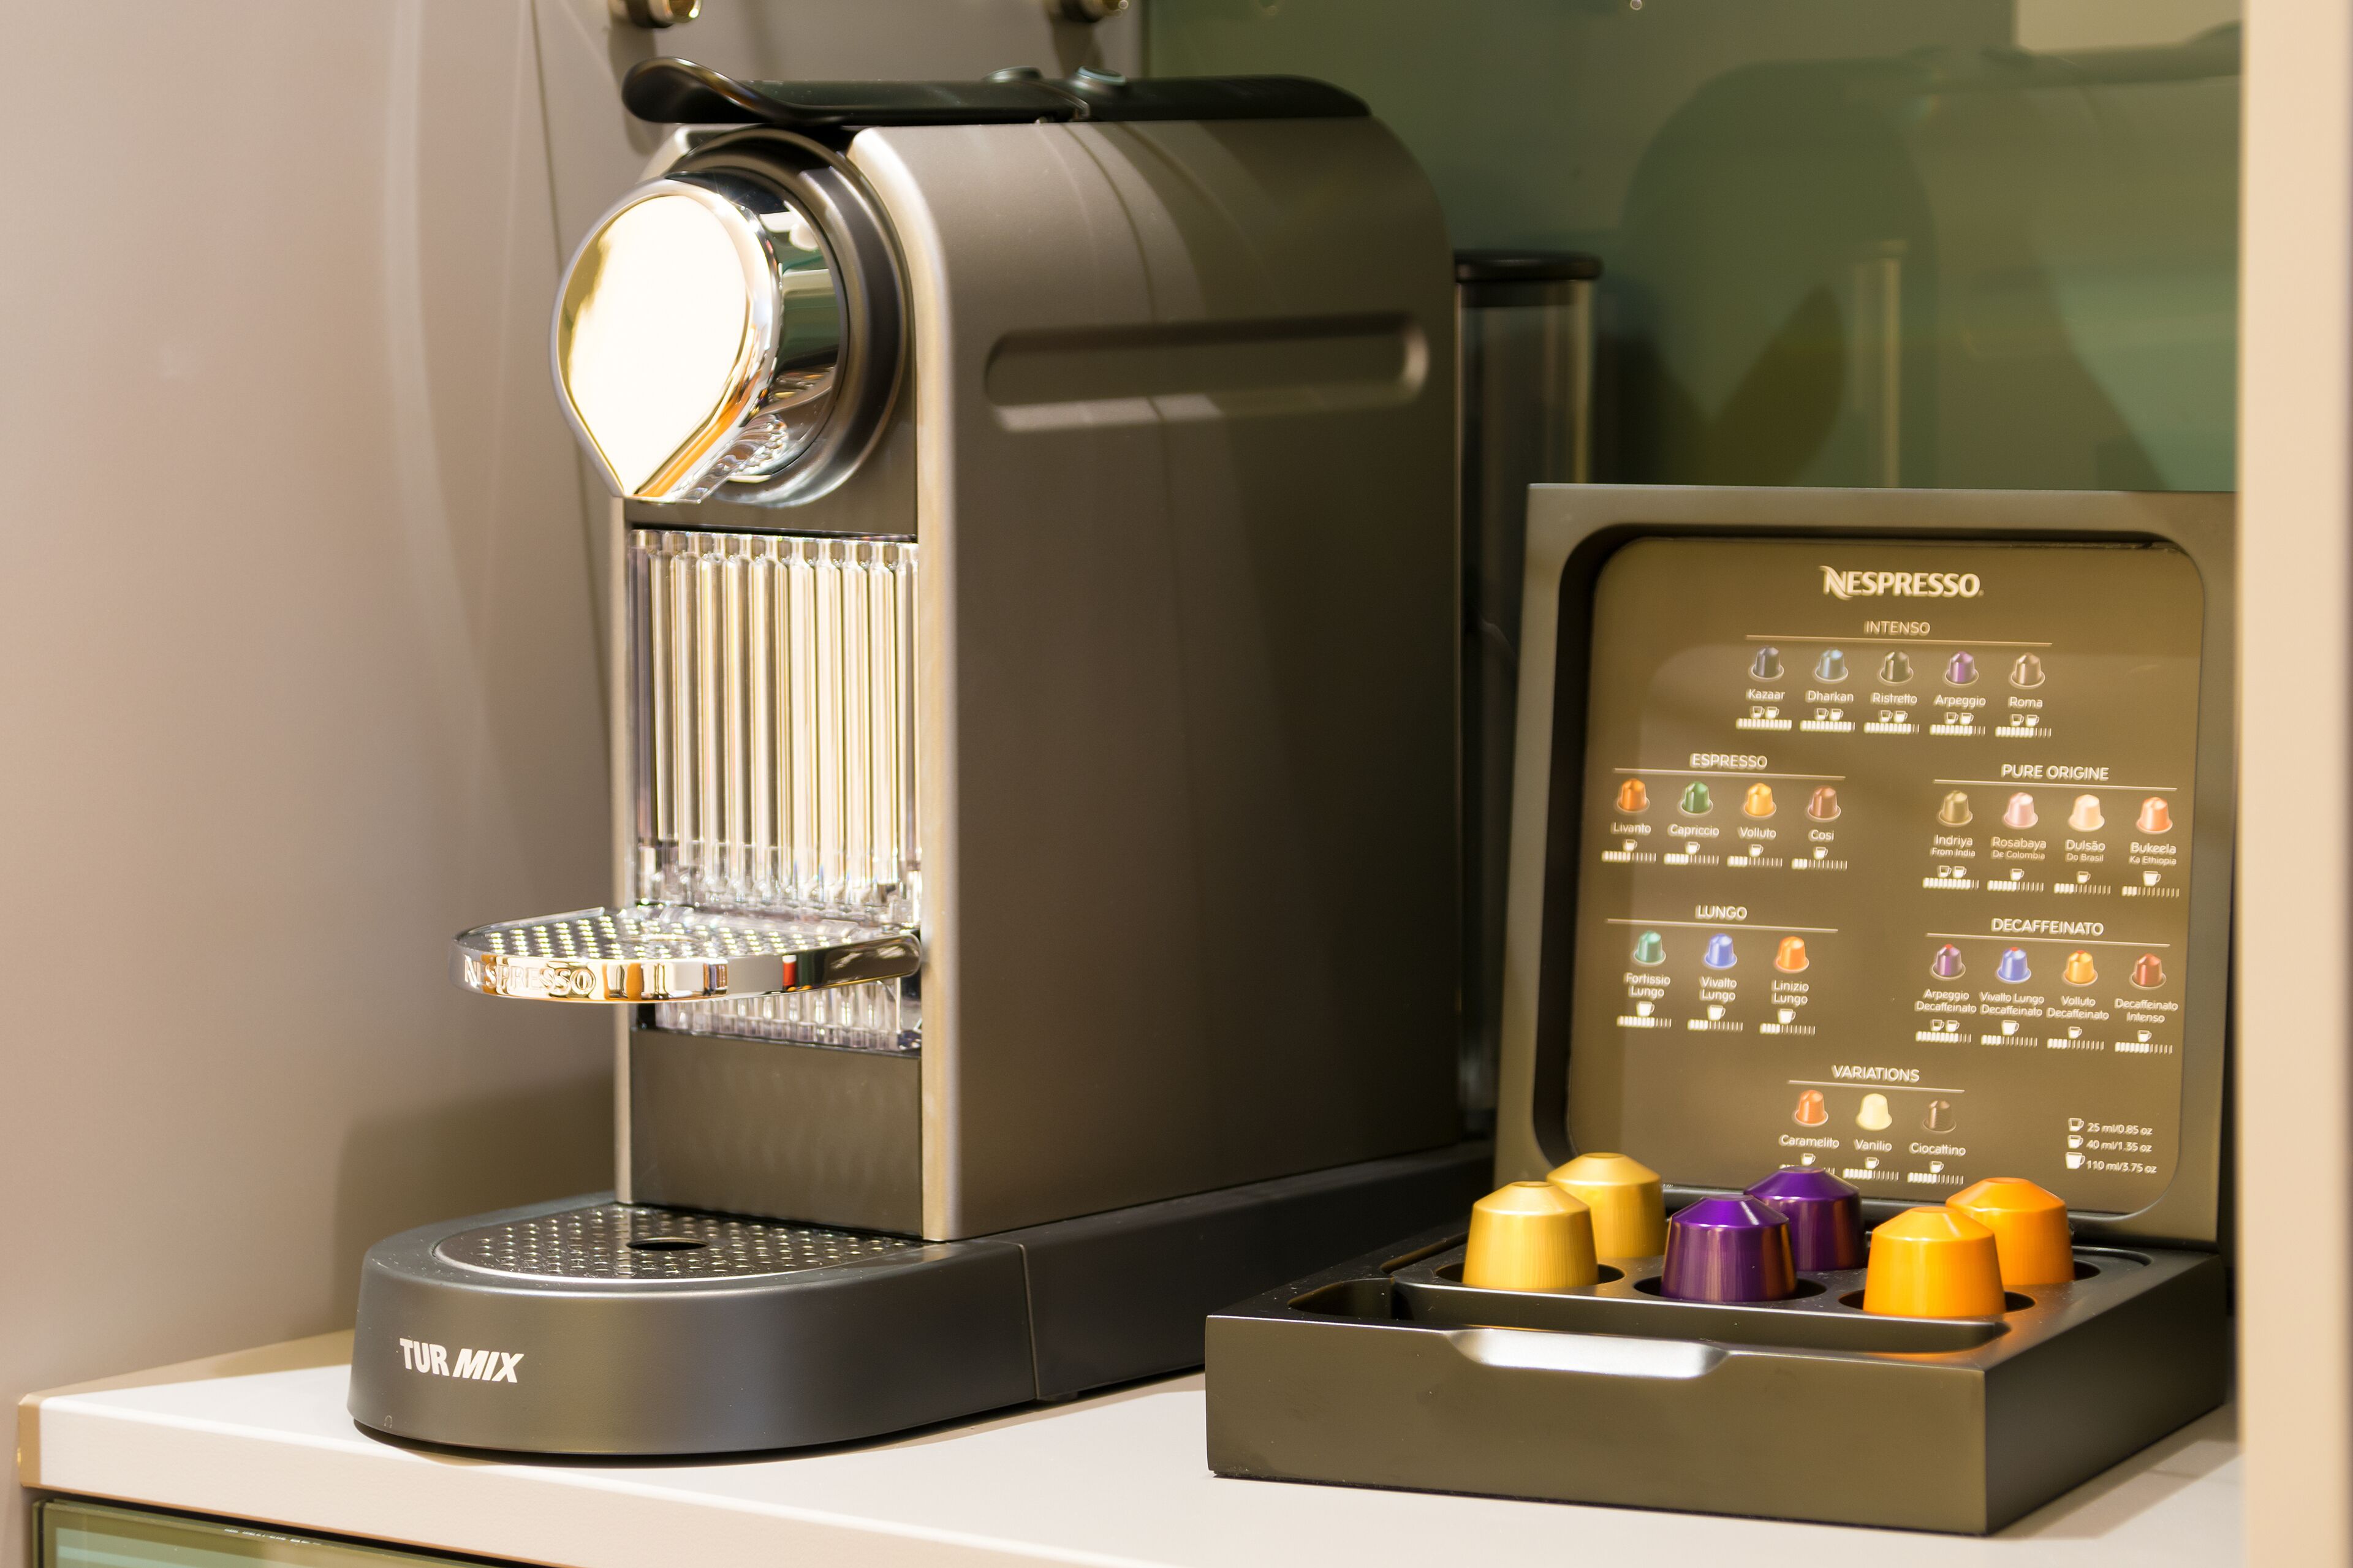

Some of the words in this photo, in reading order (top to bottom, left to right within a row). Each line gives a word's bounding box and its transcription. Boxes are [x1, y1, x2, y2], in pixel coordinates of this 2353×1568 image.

[1819, 565, 1981, 600] NESPRESSO
[1863, 620, 1931, 636] INTENSO
[1746, 689, 1786, 701] Kazaar
[1805, 690, 1854, 703] Dharkan
[1871, 692, 1917, 705] Ristretto
[1933, 694, 1987, 709] Arpeggio
[2008, 696, 2044, 709] Roma
[1689, 753, 1768, 770] ESPRESSO
[2001, 763, 2043, 779] PURE
[2047, 765, 2109, 781] ORIGINE
[1610, 822, 1651, 836] Livanto
[1667, 824, 1720, 838] Capriccio
[1737, 827, 1776, 839] Volluto
[1808, 830, 1834, 842] Cosi
[1933, 835, 1973, 848] Indriya
[1990, 836, 2047, 850] Rosabaya
[2065, 839, 2105, 853] Dulsão
[2130, 841, 2177, 855] Bukeela
[1930, 848, 1953, 857] From
[1954, 849, 1976, 858] India
[1991, 850, 2005, 859] De
[2005, 850, 2045, 861] Colombia
[2066, 853, 2079, 862] Do
[2080, 853, 2104, 863] Brasil
[2128, 855, 2140, 864] Ka
[2142, 856, 2177, 866] Ethiopia
[1696, 904, 1747, 920] LUNGO
[1991, 918, 2104, 936] DECAFFEINATO
[1624, 972, 1671, 986] Fortissio
[1699, 976, 1737, 989] Vivalto
[1628, 986, 1664, 999] Lungo
[1771, 980, 1809, 993] Linizio
[1699, 989, 1735, 1004] Lungo
[1771, 993, 1808, 1007] Lungo
[1923, 989, 1969, 1003] Arpeggio
[1979, 991, 2012, 1004] Vivalto
[2012, 993, 2045, 1007] Lungo
[2061, 995, 2096, 1007] Volluto
[1914, 1001, 1977, 1015] Decaffeinato
[1980, 1004, 2043, 1018] Decaffeinato
[2114, 998, 2178, 1012] Decaffeinato
[2047, 1007, 2109, 1021] Decaffeinato
[2126, 1012, 2165, 1024] Intenso
[1831, 1064, 1920, 1083] VARIATIONS
[2087, 1123, 2100, 1132] 25
[2102, 1124, 2139, 1135] ml/0.85
[2140, 1127, 2153, 1136] oz
[1778, 1134, 1840, 1149] Caramelito
[1853, 1138, 1892, 1152] Vanilio
[2086, 1140, 2099, 1149] 40
[2101, 1142, 2138, 1152] ml/1.35
[1909, 1142, 1966, 1157] Ciocattino
[2086, 1160, 2104, 1170] 110
[2105, 1162, 2143, 1173] ml/3.75
[2144, 1165, 2157, 1174] oz
